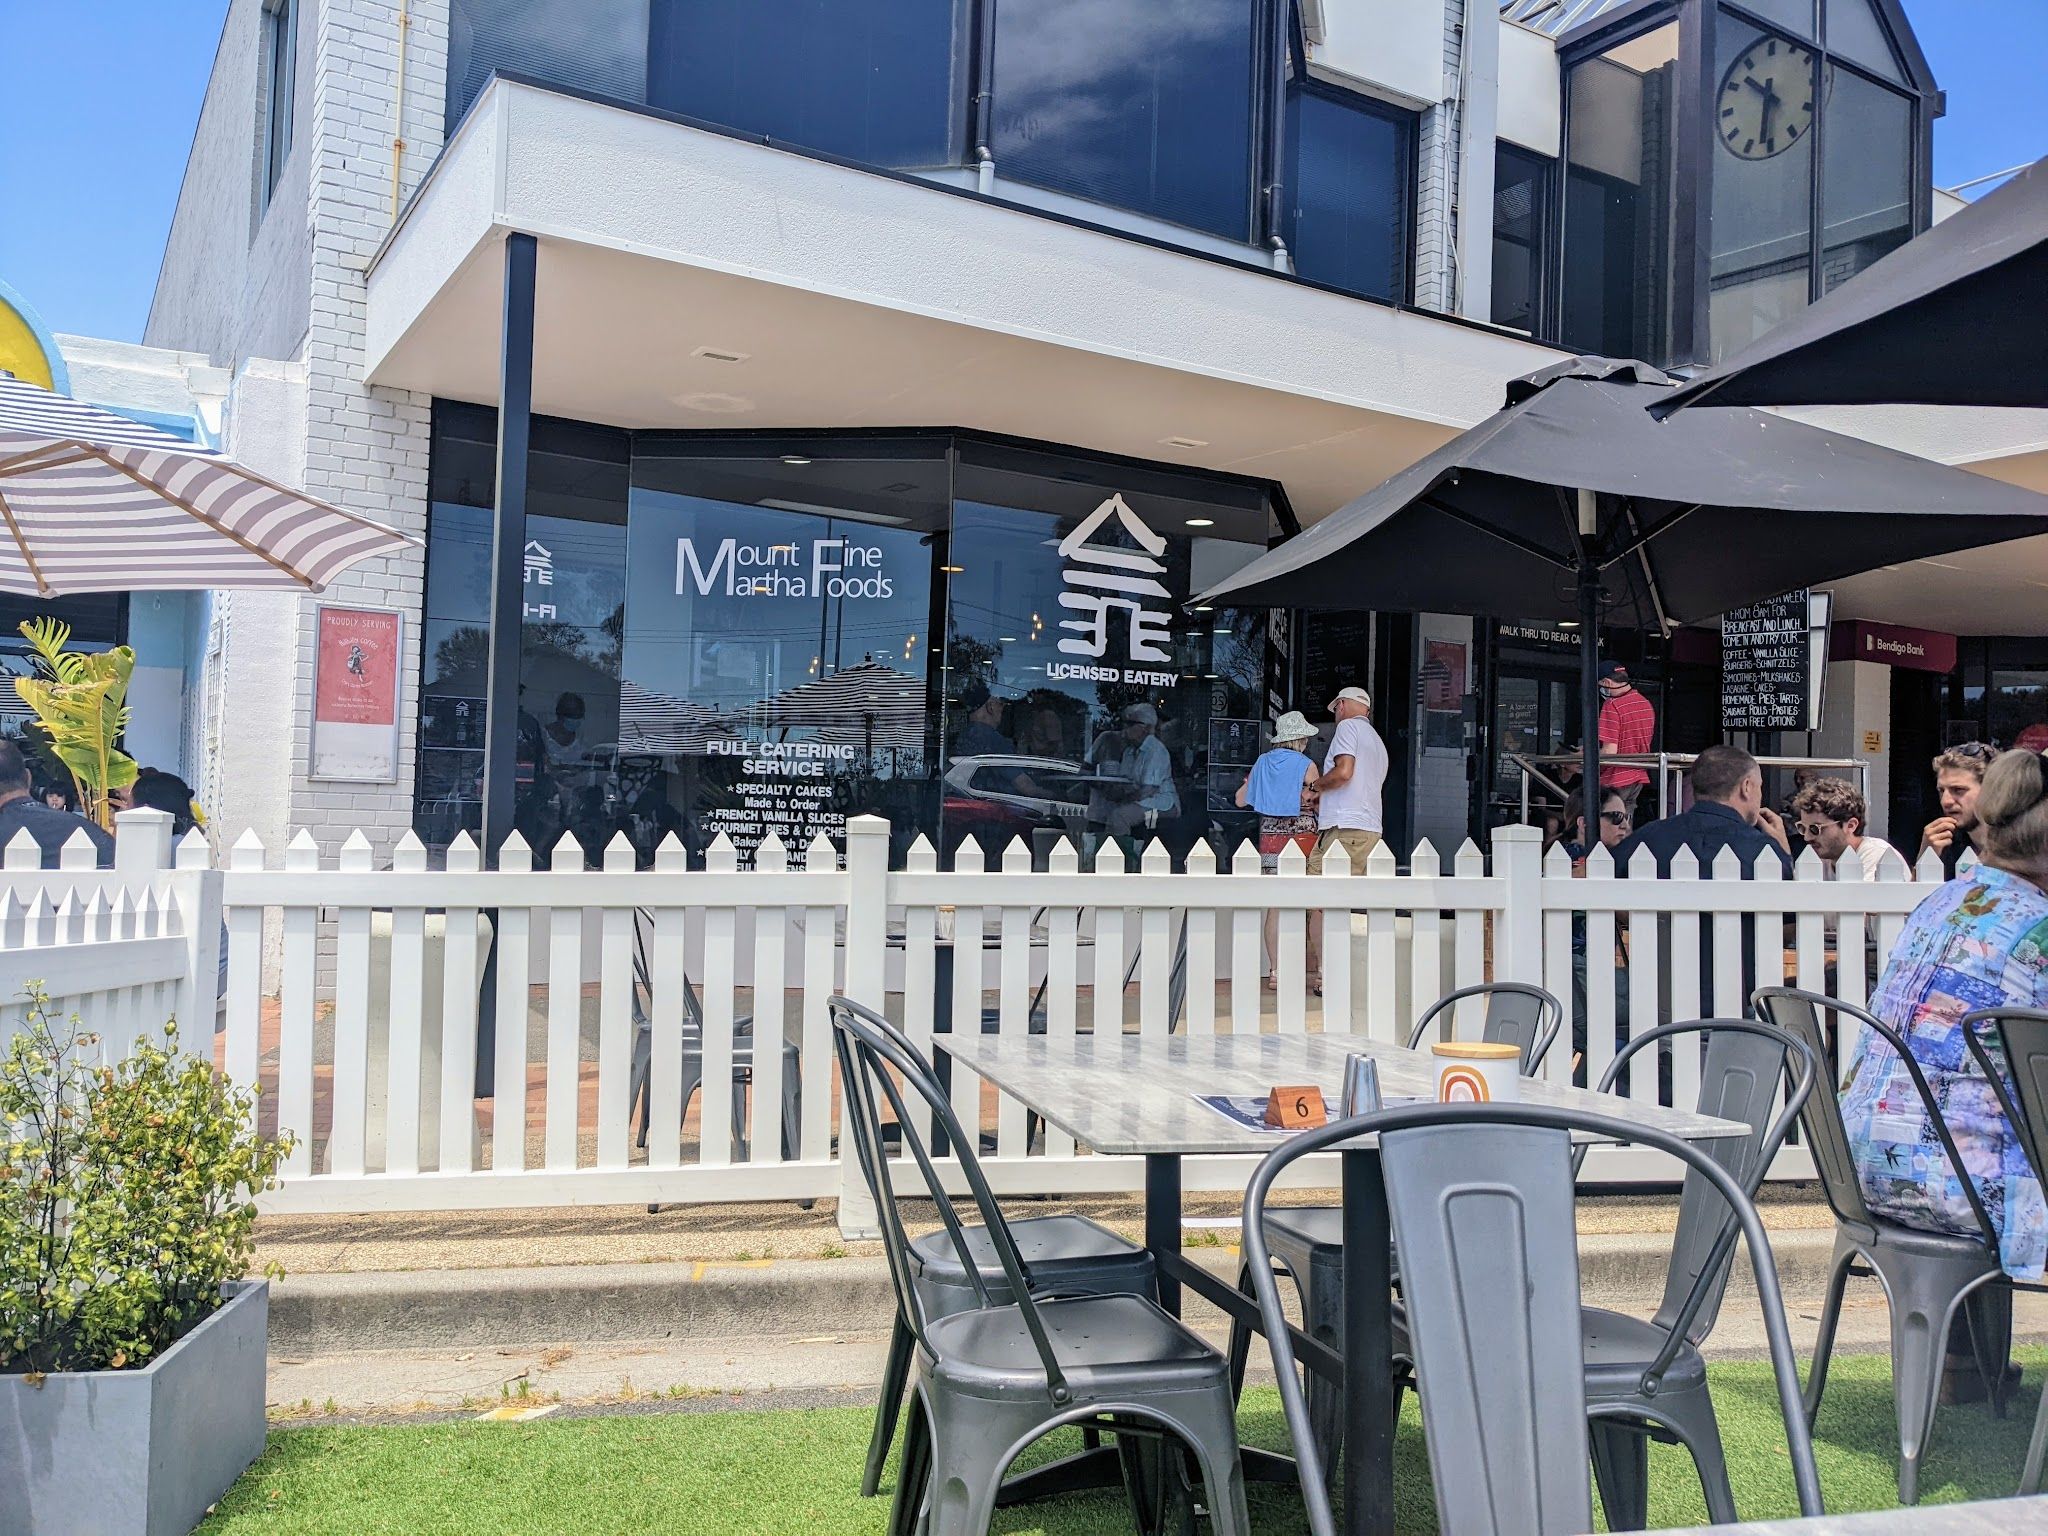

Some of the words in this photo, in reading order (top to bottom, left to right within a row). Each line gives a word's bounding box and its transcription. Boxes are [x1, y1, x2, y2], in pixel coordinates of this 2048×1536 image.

[1783, 590, 1806, 603] WEEK
[1730, 607, 1750, 619] FROM
[1753, 603, 1770, 618] 8AM
[1772, 604, 1787, 616] FOR
[327, 616, 358, 628] PROUDLY
[363, 619, 391, 630] SERVING
[1723, 620, 1761, 634] BREAKFAST
[1763, 618, 1776, 631] AND
[1500, 625, 1519, 637] WALK
[1520, 627, 1539, 639] THRU
[1540, 630, 1550, 641] TO
[1551, 631, 1569, 643] REAR
[1722, 636, 1742, 647] COME
[1743, 635, 1749, 646] IN
[1764, 633, 1779, 645] TRY
[1722, 649, 1748, 660] COFFEE
[1752, 648, 1778, 659] VANILLA
[1780, 646, 1799, 658] SLICE
[1877, 638, 1906, 656] Bendigo
[1907, 642, 1924, 656] Bank
[1047, 662, 1119, 683] LICENSED
[1124, 669, 1178, 688] EATERY
[1722, 684, 1750, 694] LASAGNE
[1722, 694, 1757, 705] HOMEMADE
[1722, 705, 1747, 717] SAUSAGE
[1722, 717, 1747, 727] GLUTEN
[1749, 716, 1765, 727] FREE
[1767, 715, 1796, 727] OPTIONS
[706, 741, 752, 755] FULL
[760, 742, 855, 759] CATERING
[742, 760, 825, 777] SERVICE
[736, 783, 792, 796] SPECIALTY
[795, 785, 832, 797] CAKES
[745, 797, 772, 809] Made
[776, 798, 786, 809] to
[790, 798, 820, 811] Order
[715, 809, 758, 821] FRENCH
[762, 810, 804, 823] VANILLA
[807, 812, 845, 825] SLICES
[710, 822, 762, 834] GOURMET
[766, 823, 789, 836] PIES
[793, 825, 800, 836] &
[1296, 1097, 1309, 1118] 6
